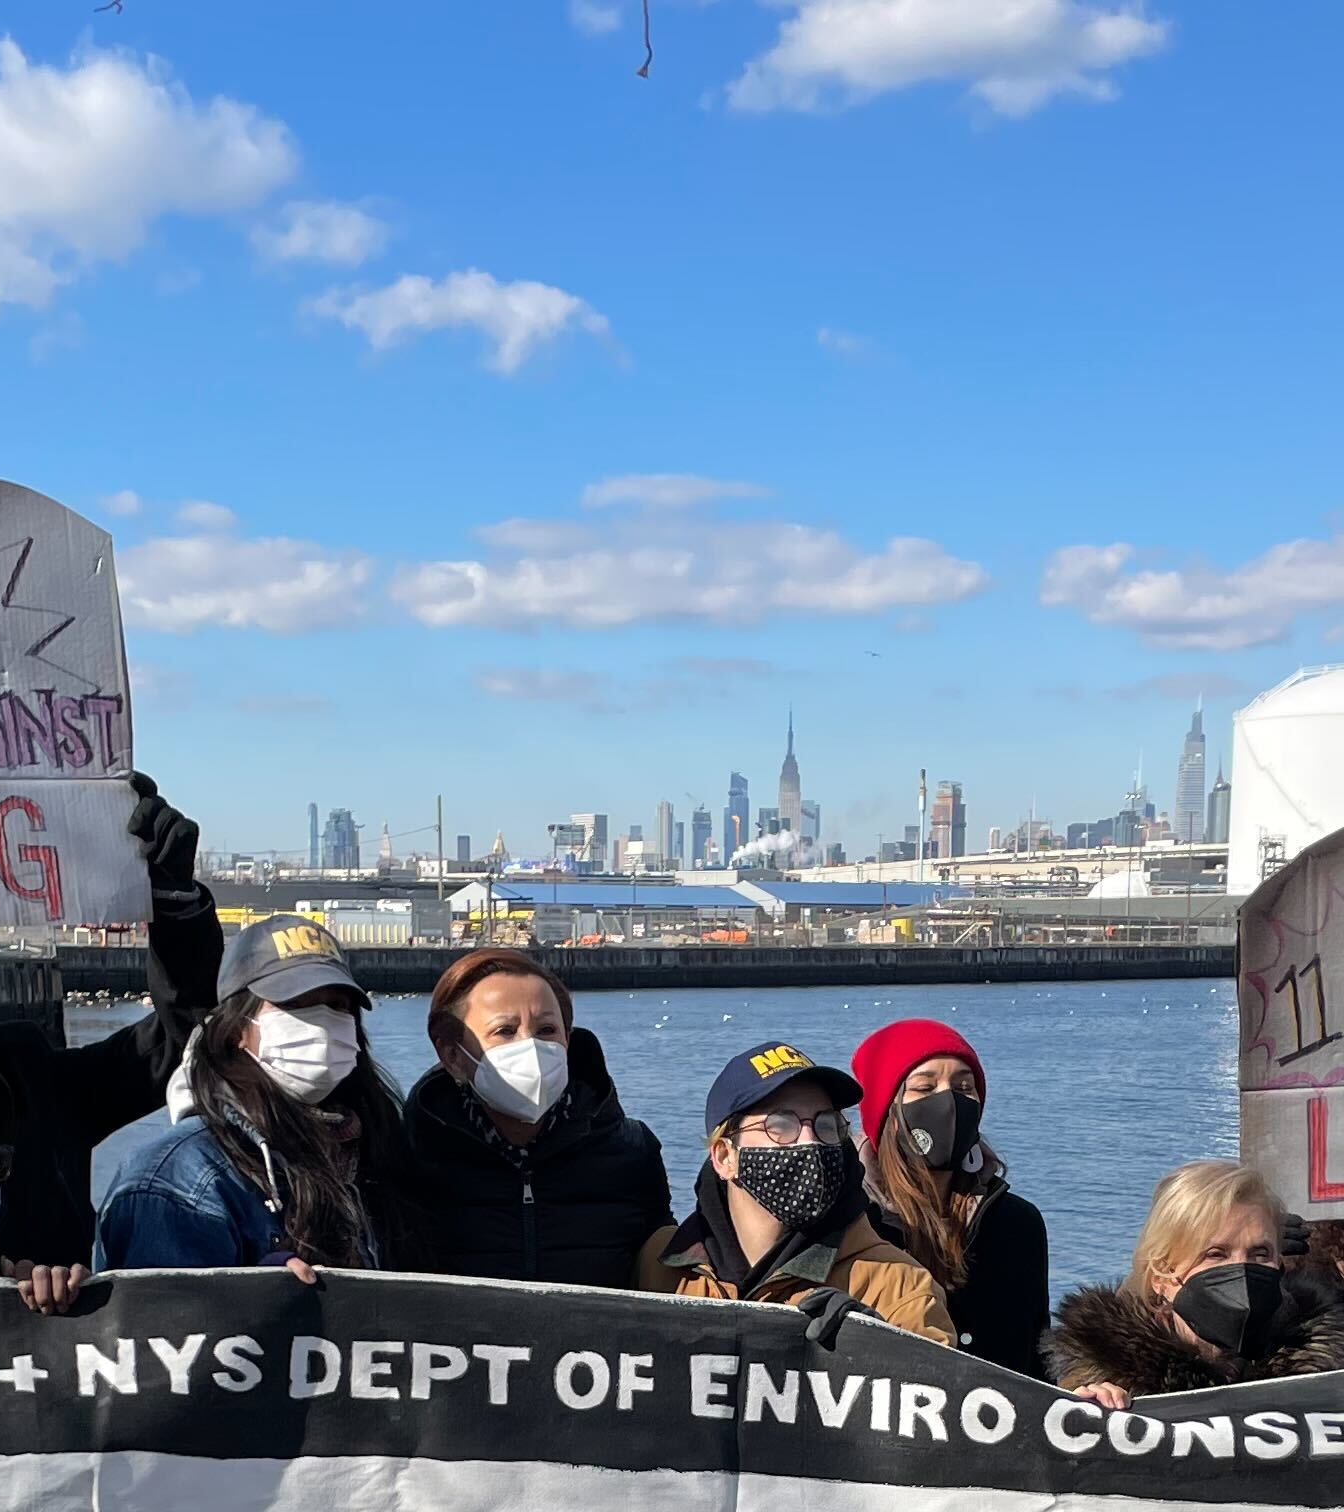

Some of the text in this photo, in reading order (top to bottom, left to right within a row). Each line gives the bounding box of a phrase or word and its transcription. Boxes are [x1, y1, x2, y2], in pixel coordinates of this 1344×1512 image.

[76, 1334, 263, 1397] NYS
[289, 1334, 534, 1406] DEPT
[554, 1348, 656, 1412] OF
[690, 1353, 1016, 1445] ENVIRO
